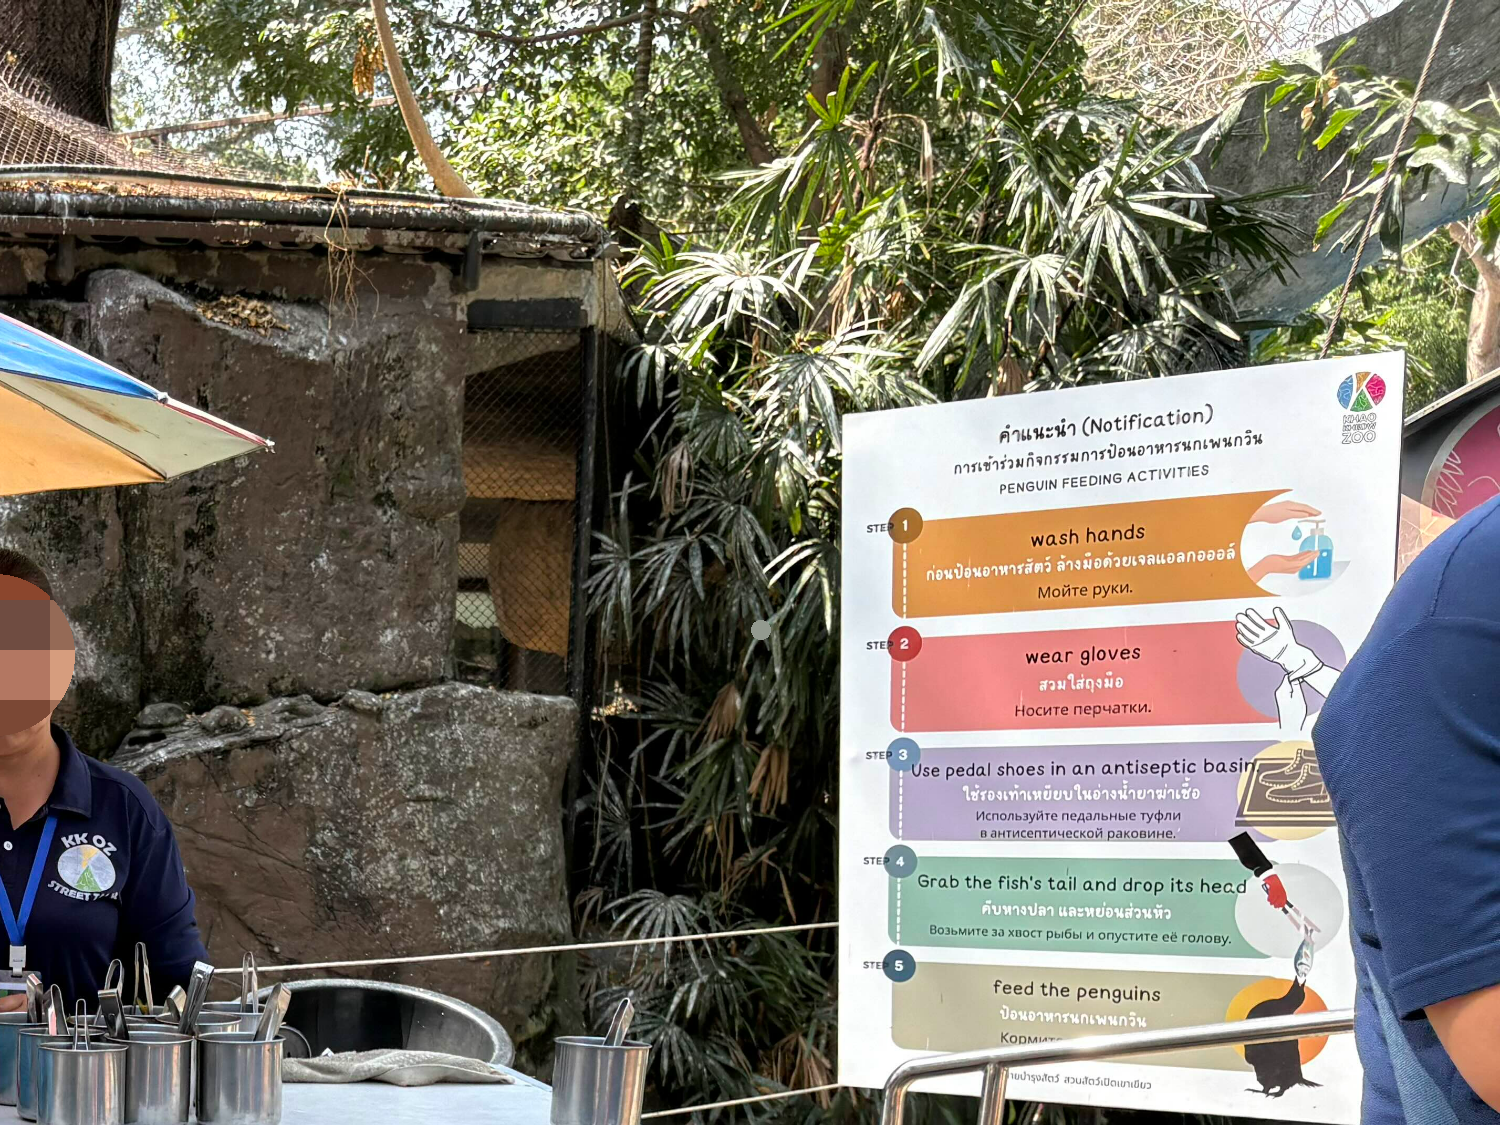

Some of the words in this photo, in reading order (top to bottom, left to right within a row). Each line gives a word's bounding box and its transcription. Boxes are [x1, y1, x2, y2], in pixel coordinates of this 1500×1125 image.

[999, 422, 1077, 444] คำแนะนำ
[1082, 403, 1214, 437] (Notification)
[1342, 412, 1377, 424] KHAO
[1341, 430, 1376, 444] ZOO
[999, 479, 1057, 495] PENGUIN
[1062, 473, 1123, 489] FEEDING
[1127, 464, 1209, 483] ACTIVITIES
[866, 523, 894, 534] STEP
[902, 519, 908, 532] 1
[1031, 527, 1079, 548] wash
[1086, 524, 1145, 543] hands
[1038, 584, 1087, 600] Мойте
[1093, 582, 1133, 601] руки.
[866, 640, 893, 650] STEP
[900, 638, 909, 650] 2
[1025, 649, 1073, 664] wear
[1080, 645, 1141, 666] gloves
[1014, 704, 1068, 718] Носите
[1073, 702, 1152, 720] перчатки.
[866, 751, 893, 760] STEP
[898, 749, 908, 761] 3
[911, 763, 940, 778] Use
[945, 761, 992, 780] pedal
[996, 761, 1045, 777] shoes
[1050, 760, 1066, 776] in
[1072, 763, 1096, 776] an
[1101, 760, 1197, 780] antiseptic
[975, 810, 1058, 823] Используйте
[1061, 811, 1136, 822] педальные
[1140, 810, 1182, 823] туфли
[61, 833, 88, 848] KK
[92, 834, 118, 856] OZ
[980, 830, 987, 839] в
[990, 828, 1103, 839] антисептической
[1107, 830, 1177, 842] раковине.
[863, 857, 890, 866] STEP
[895, 856, 905, 868] 4
[47, 880, 92, 901] STREET
[917, 873, 960, 889] Grab
[965, 874, 993, 890] the
[998, 875, 1042, 891] fish's
[1048, 875, 1077, 892] tail
[1083, 876, 1117, 893] and
[1122, 876, 1164, 897] drop
[1170, 877, 1194, 894] its
[1200, 878, 1248, 895] head
[929, 924, 988, 938] Возьмите
[991, 928, 1005, 937] за
[1008, 928, 1042, 939] хвост
[1046, 928, 1082, 941] рыбы
[1086, 931, 1094, 939] и
[1098, 931, 1158, 944] опустите
[1162, 931, 1177, 942] её
[1182, 933, 1232, 947] голову.
[863, 961, 889, 970] STEP
[894, 961, 904, 972] 5
[993, 979, 1034, 996] feed
[1040, 982, 1070, 998] the
[1077, 985, 1161, 1003] penguins
